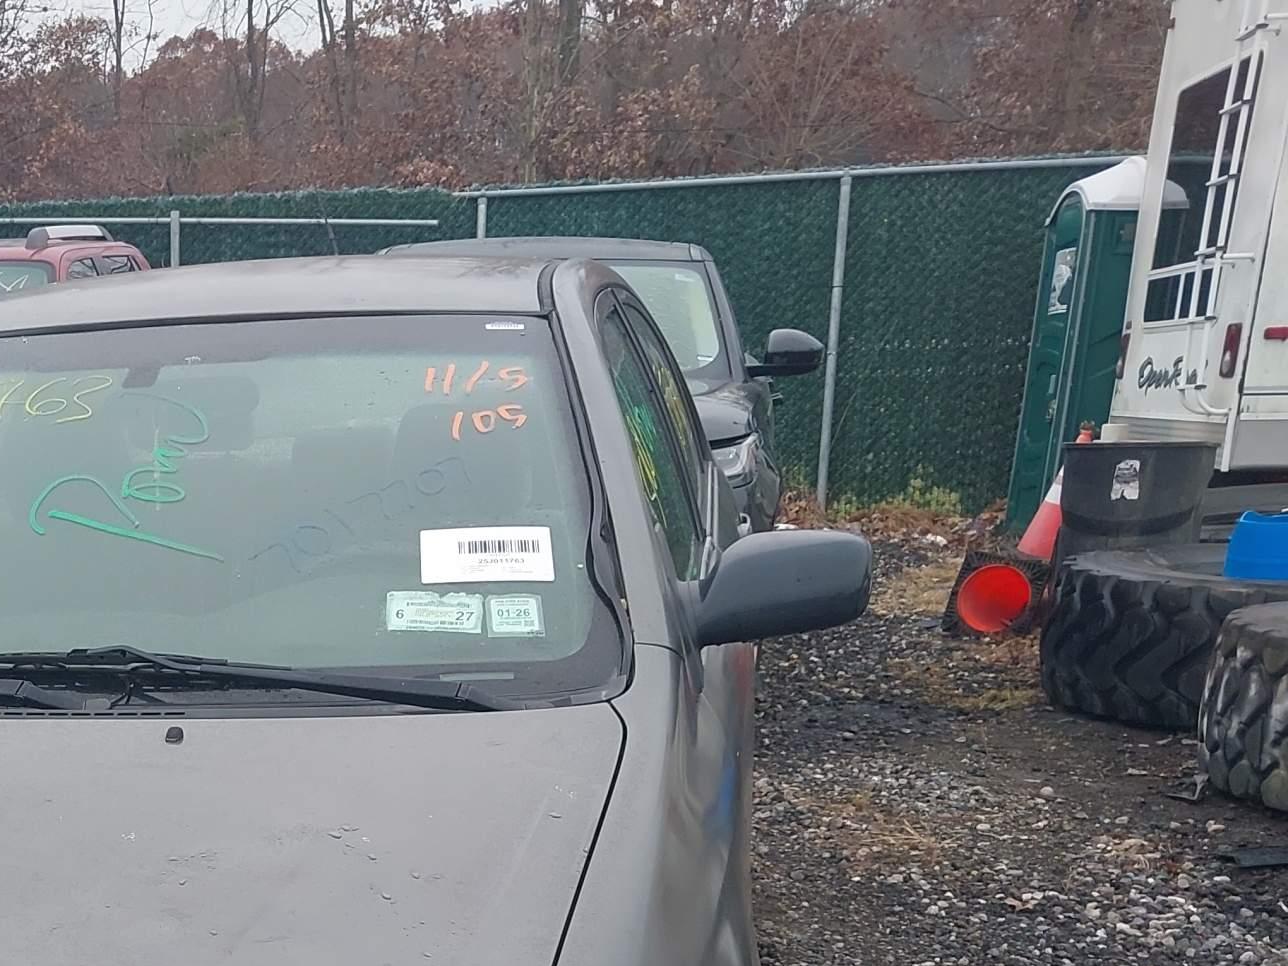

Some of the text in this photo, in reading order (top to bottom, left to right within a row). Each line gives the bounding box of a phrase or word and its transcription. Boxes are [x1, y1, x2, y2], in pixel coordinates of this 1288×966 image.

[395, 608, 474, 621] 6 27
[496, 607, 531, 618] 01-26
